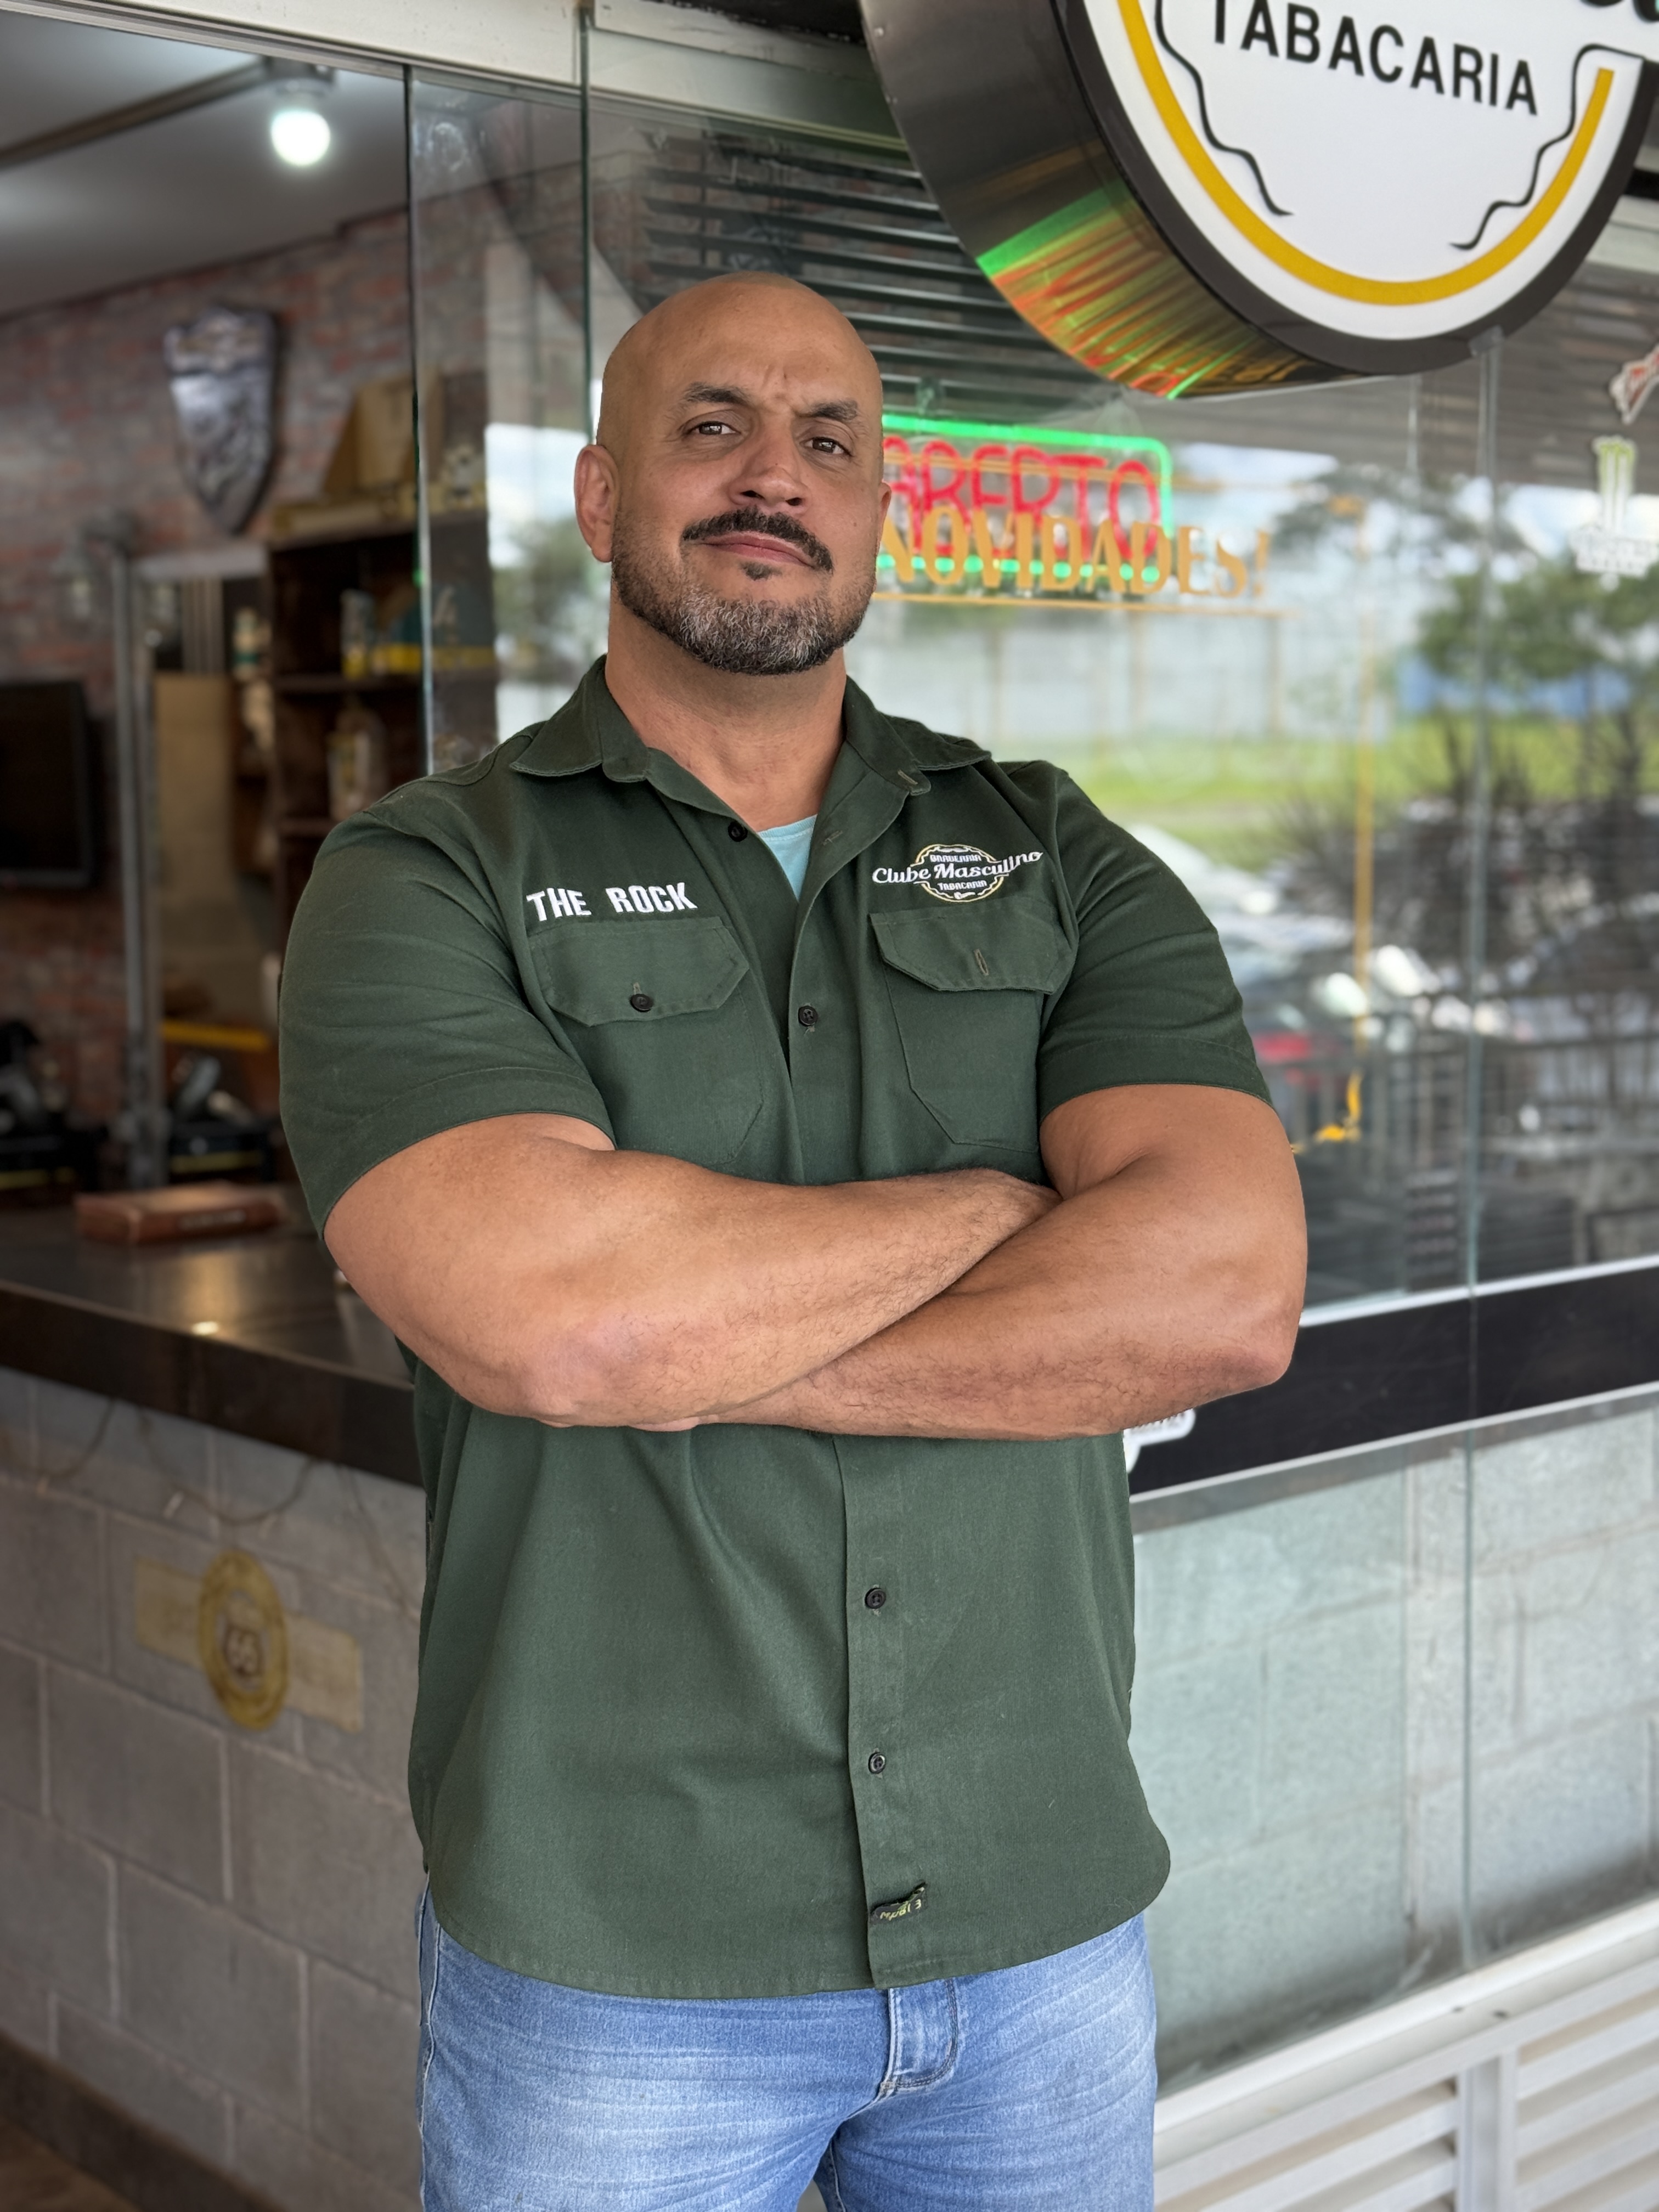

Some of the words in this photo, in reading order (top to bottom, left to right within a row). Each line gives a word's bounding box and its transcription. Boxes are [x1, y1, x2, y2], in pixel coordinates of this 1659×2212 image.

[872, 865, 932, 884] Clube
[934, 851, 1043, 879] Masculino
[526, 888, 592, 922] THE
[605, 882, 698, 913] ROCK
[937, 880, 987, 891] TABACARIA
